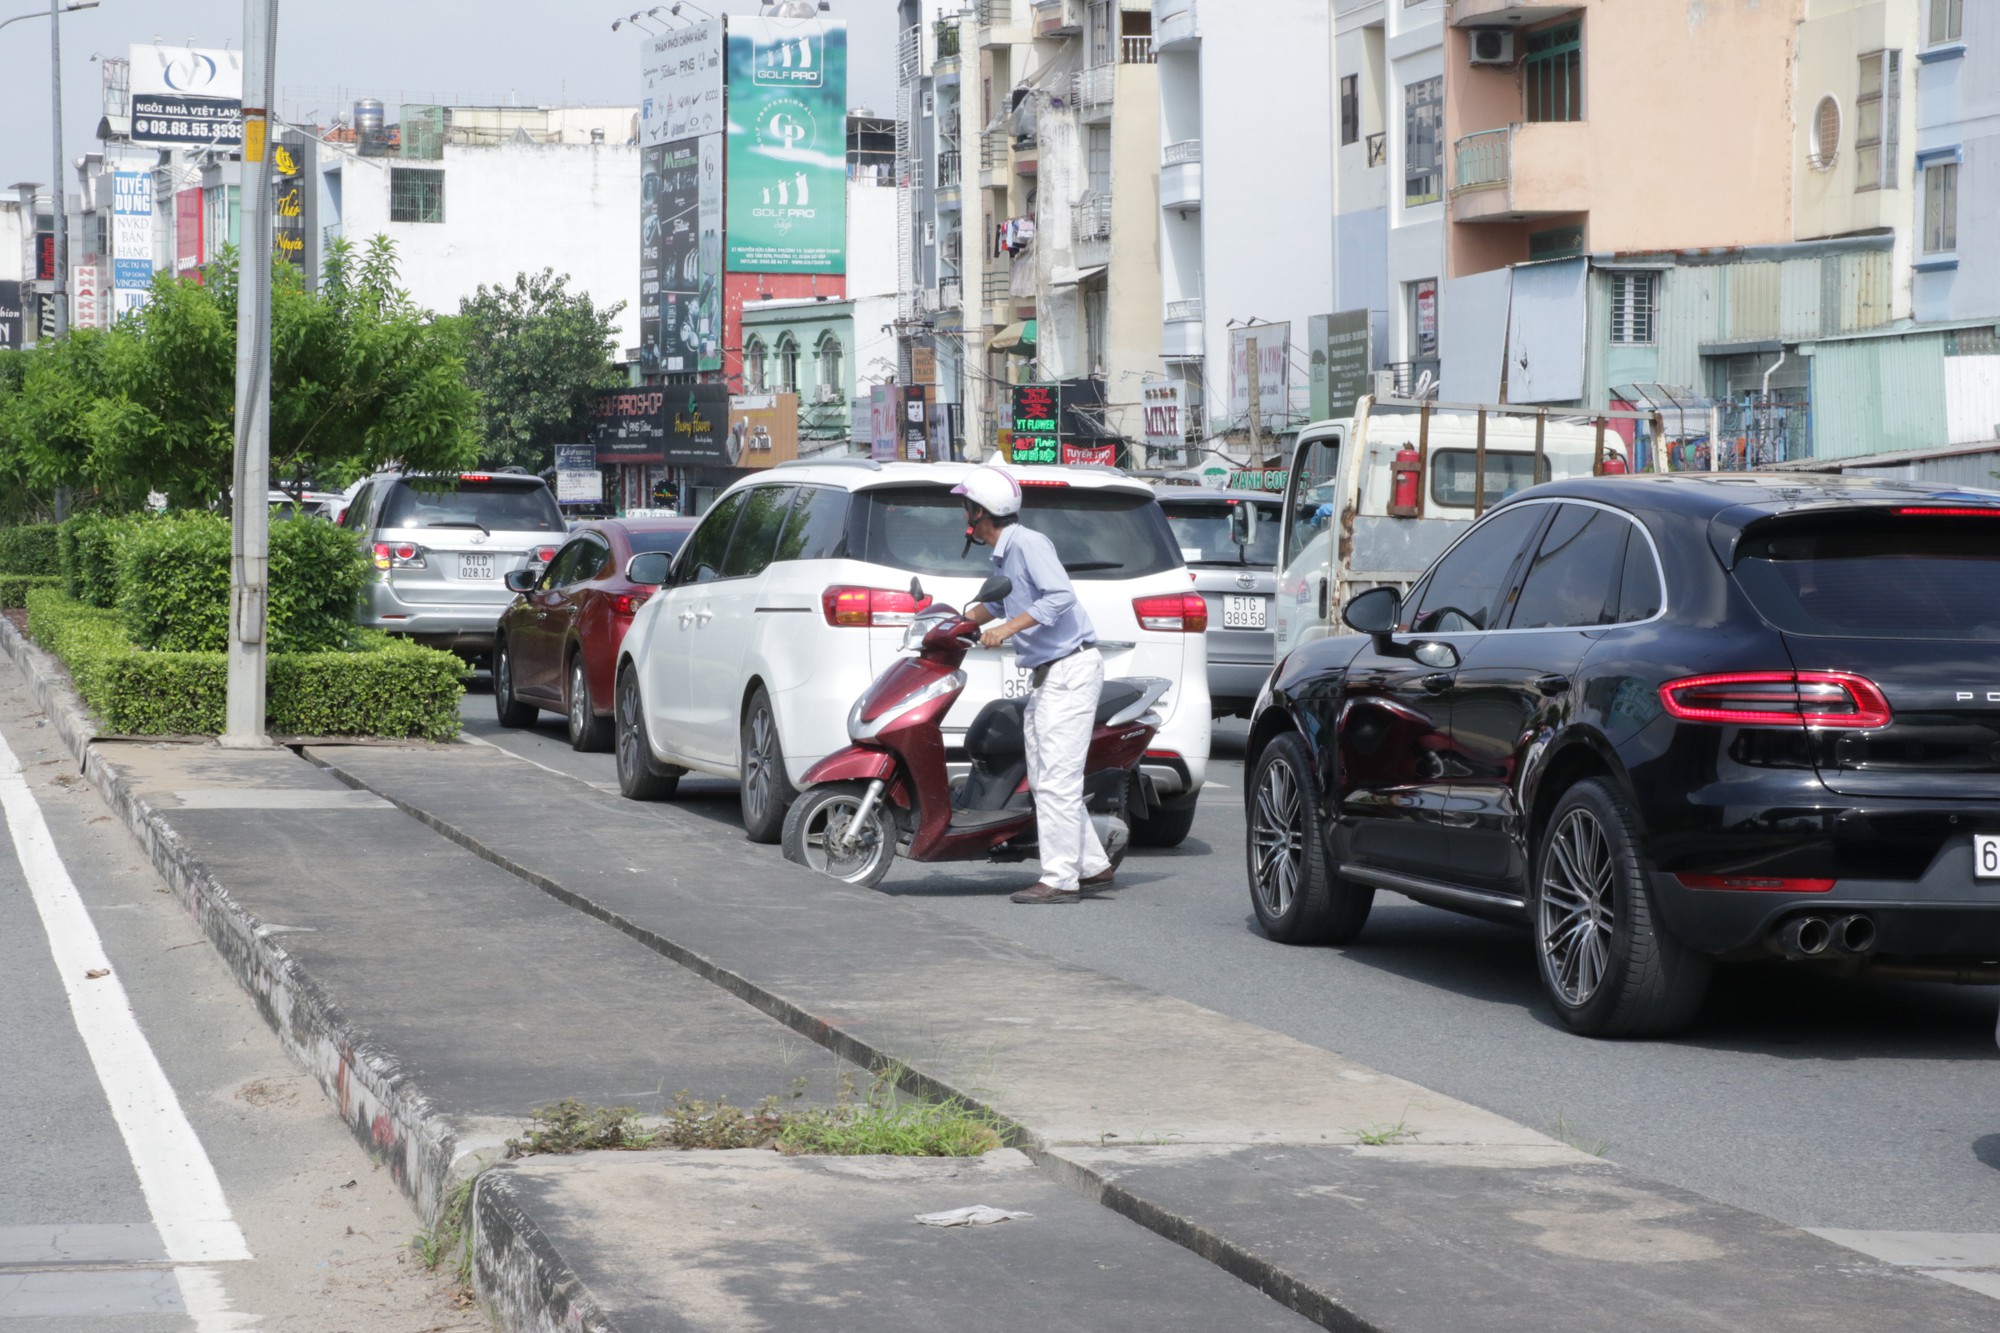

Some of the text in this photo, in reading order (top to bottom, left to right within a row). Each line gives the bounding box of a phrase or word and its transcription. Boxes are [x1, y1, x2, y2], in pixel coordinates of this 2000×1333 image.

[680, 57, 695, 73] PING
[757, 70, 818, 80] GOLF PRO
[136, 101, 163, 113] NGÔI
[166, 103, 187, 115] NHÀ
[190, 105, 215, 118] VIỆT
[115, 173, 150, 195] TUYỂN
[115, 194, 151, 215] DỤNG
[752, 208, 815, 218] GOLF PRO
[117, 218, 149, 230] NVKD
[617, 395, 637, 416] PRO
[637, 392, 663, 415] SHOP
[1020, 388, 1052, 419] 꽃
[1016, 419, 1056, 430] YT FLOWER
[1144, 406, 1179, 437] MINH
[1231, 471, 1263, 490] XANH
[466, 555, 488, 566] 61LD
[462, 567, 491, 578] 028.12
[1233, 597, 1256, 611] 51G
[1225, 611, 1265, 626] 389.58
